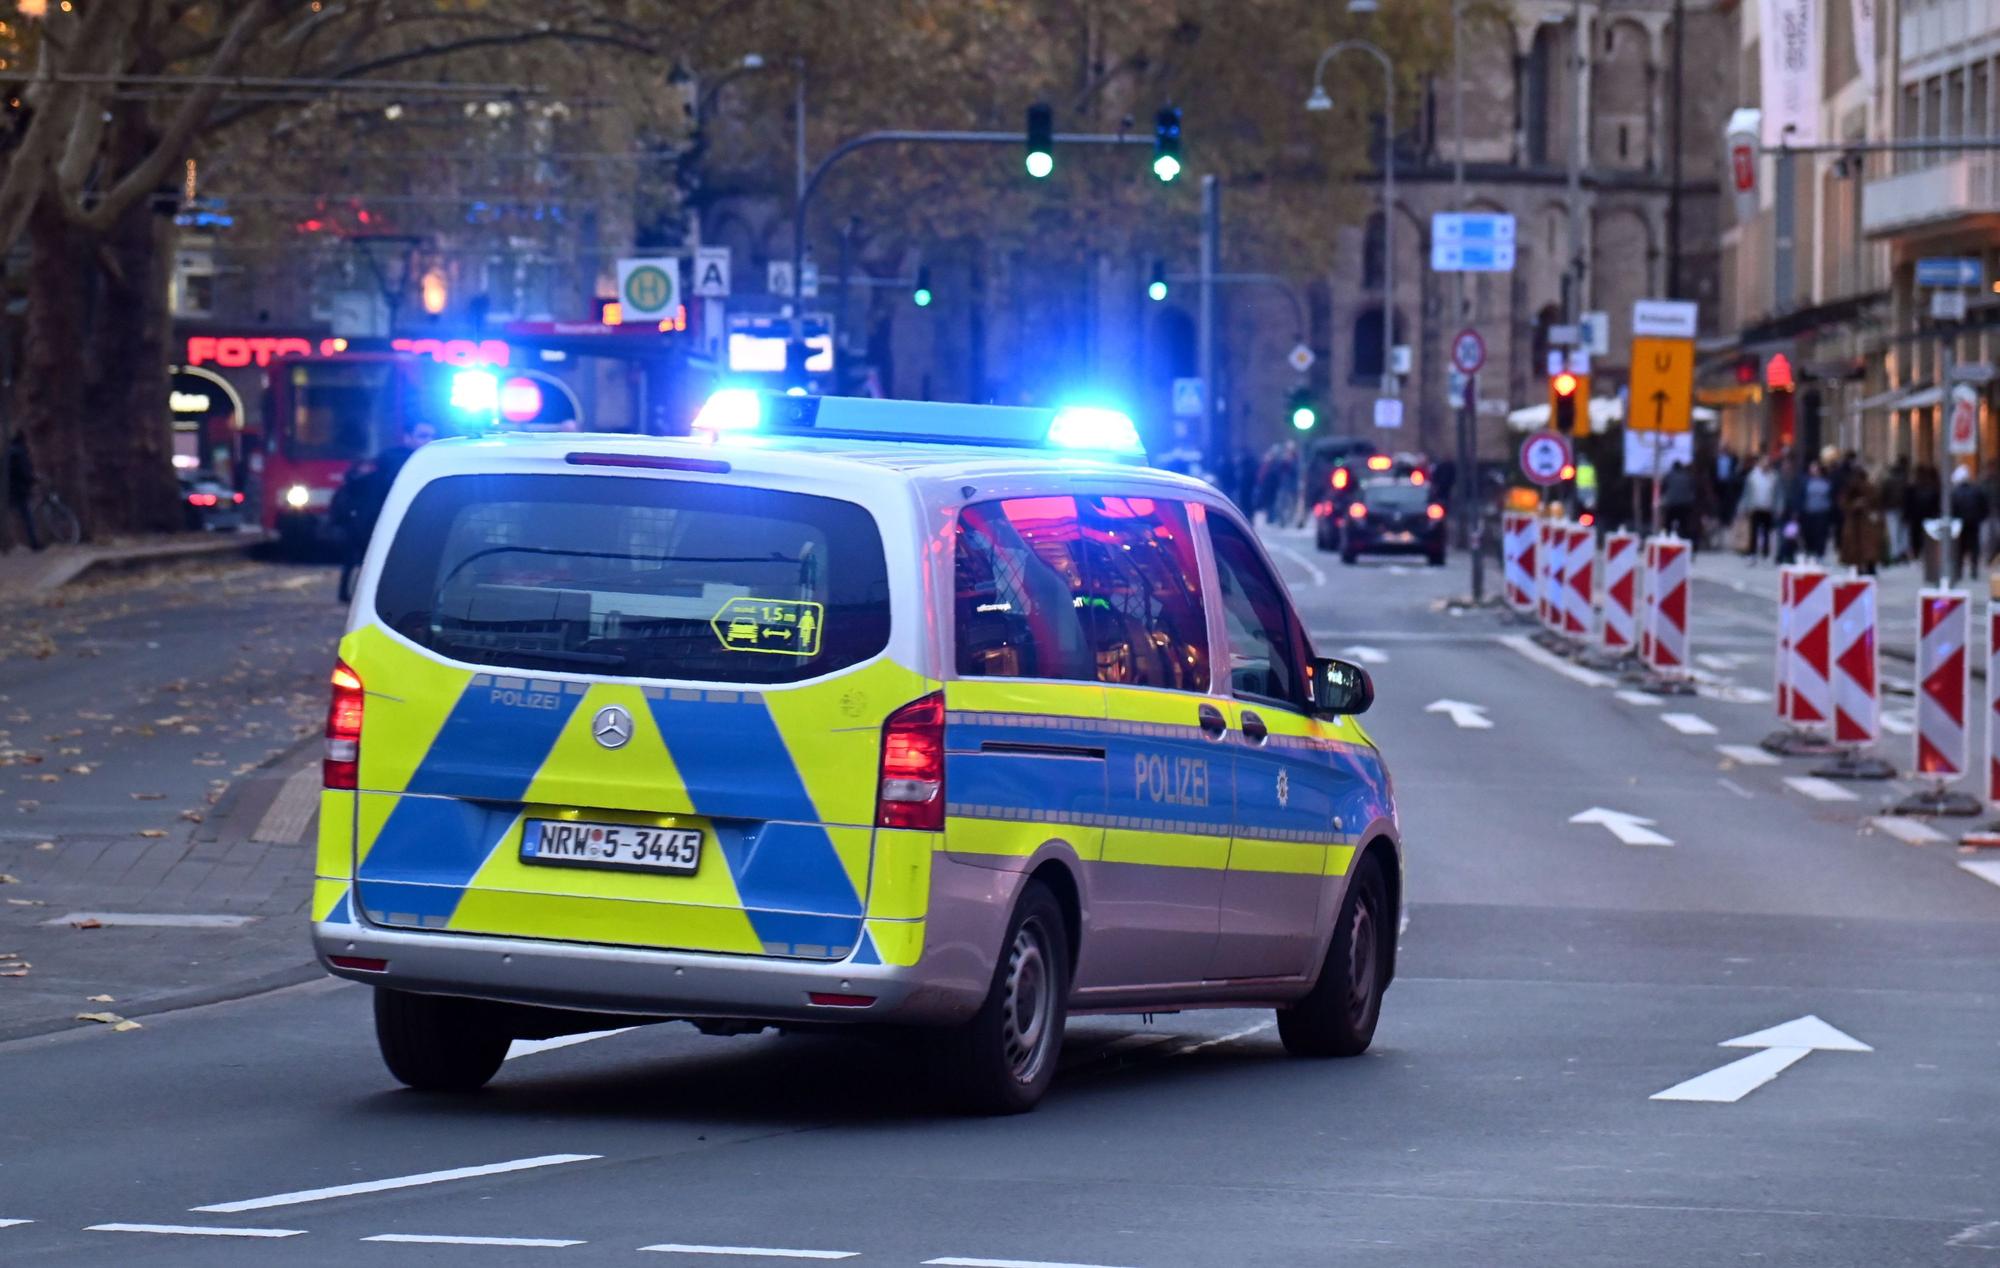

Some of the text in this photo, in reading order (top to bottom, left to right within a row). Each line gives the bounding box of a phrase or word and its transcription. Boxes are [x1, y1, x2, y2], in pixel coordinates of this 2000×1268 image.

[702, 262, 723, 287] A
[1655, 352, 1672, 373] U
[491, 690, 560, 710] POLIZEI
[1135, 752, 1208, 807] POLIZEI
[539, 823, 699, 864] NRW 5-3445
